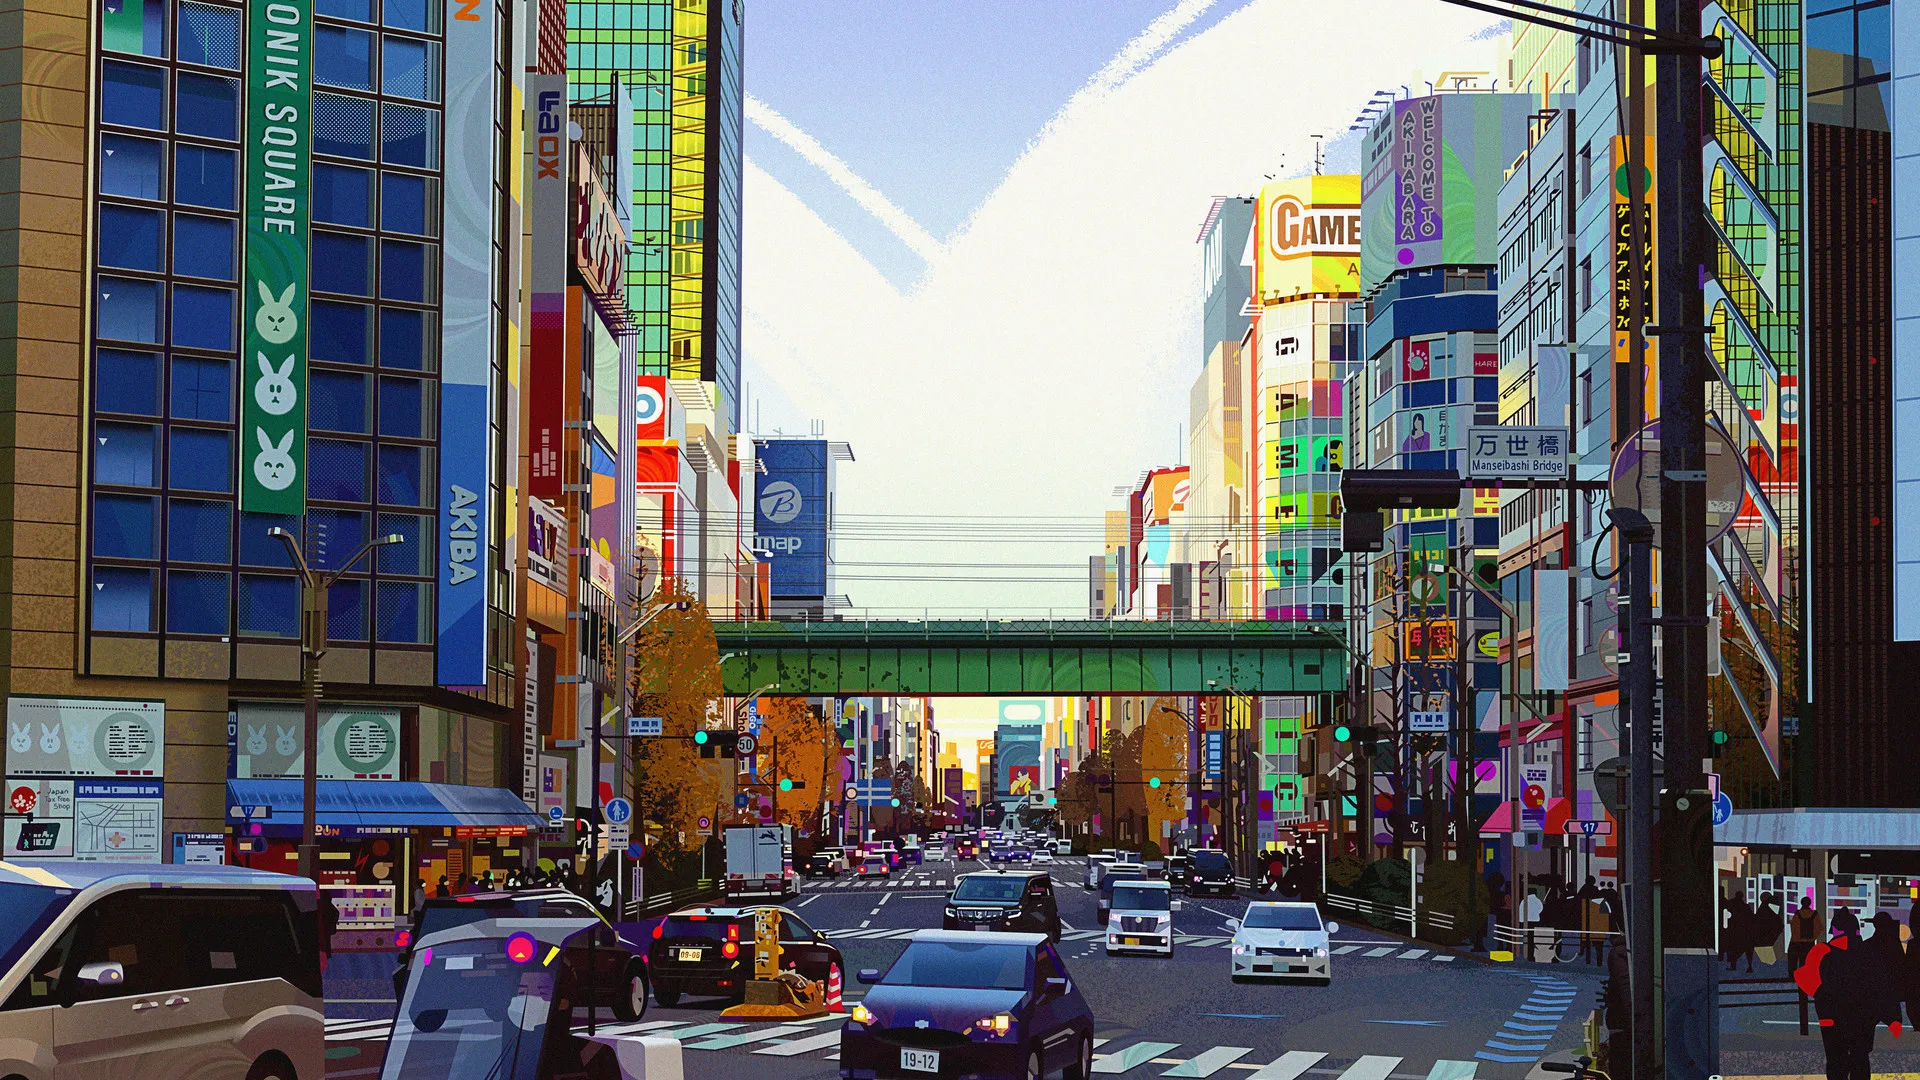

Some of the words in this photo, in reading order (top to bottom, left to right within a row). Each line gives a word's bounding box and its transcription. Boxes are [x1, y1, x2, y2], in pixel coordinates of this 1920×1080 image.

[1421, 99, 1436, 202] WELCOME
[261, 103, 298, 235] SQUARE
[1401, 111, 1416, 240] AKIHABARA
[1421, 207, 1435, 235] TO
[1475, 434, 1560, 457] 万世橋
[1472, 460, 1530, 471] Manseibashi
[1533, 460, 1563, 473] Bridge
[449, 484, 478, 586] AKIBA
[738, 739, 752, 751] 50
[47, 788, 69, 796] Japan
[53, 803, 71, 811] Shop
[1584, 822, 1595, 832] 17
[904, 1052, 935, 1069] 19-12
